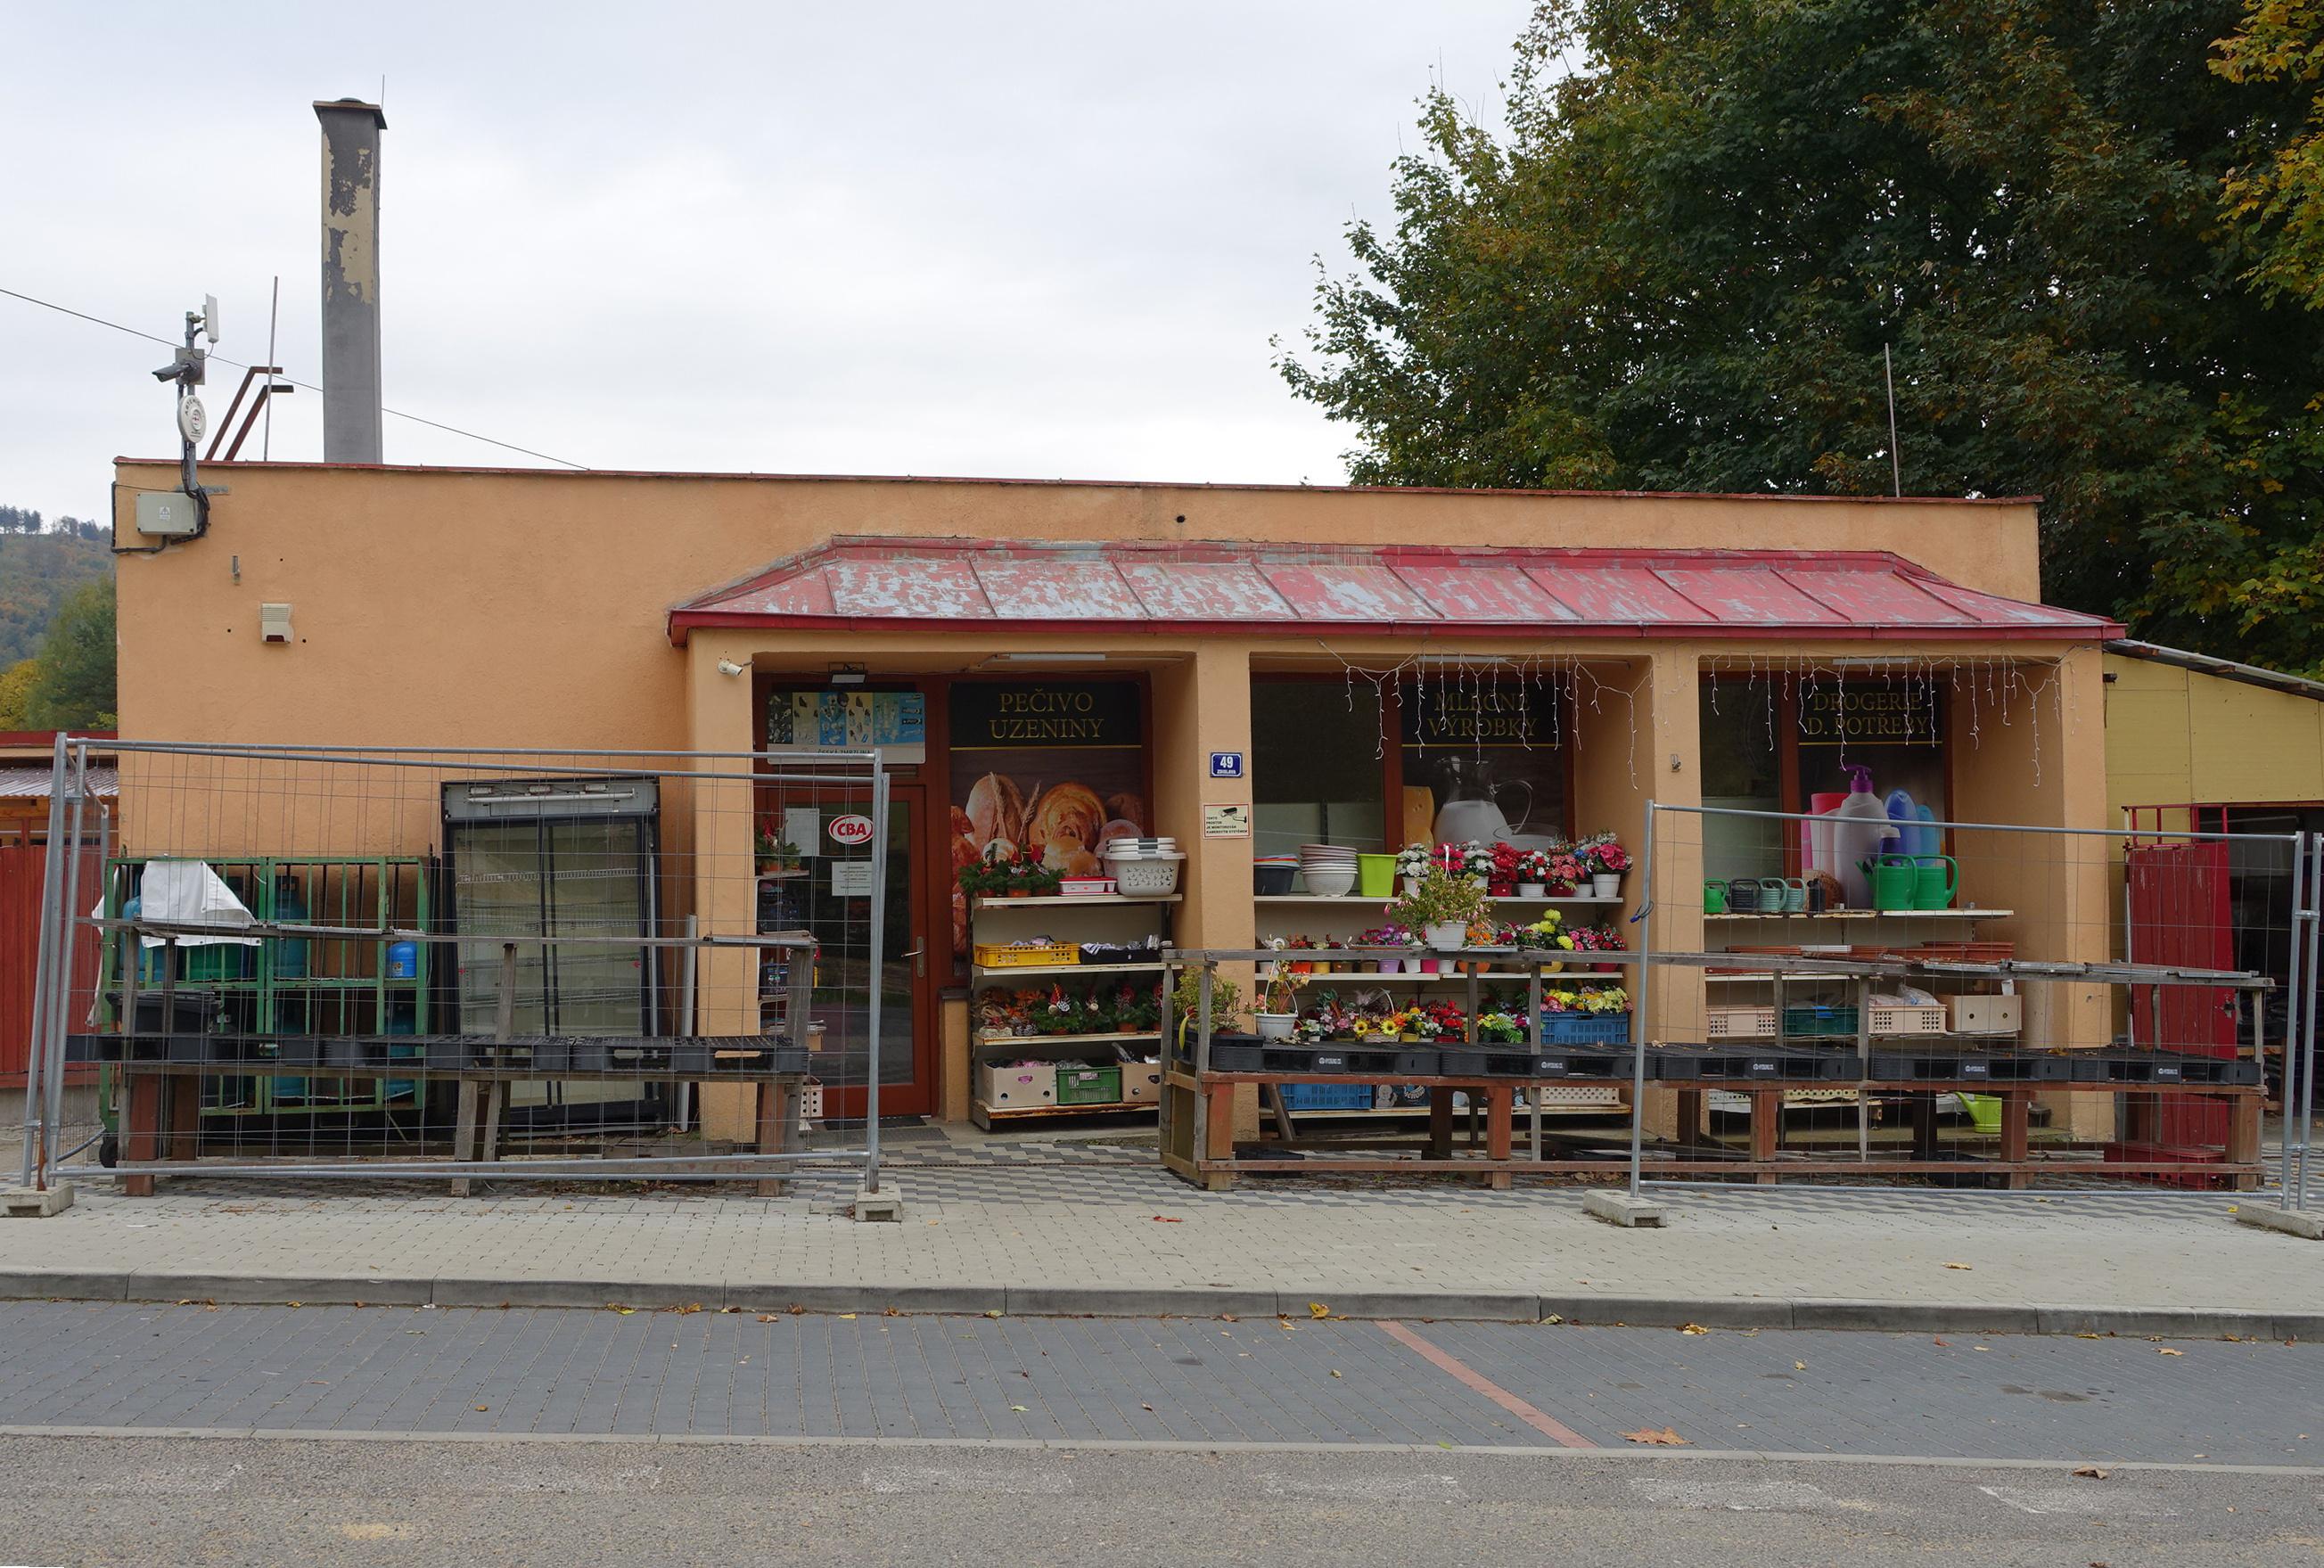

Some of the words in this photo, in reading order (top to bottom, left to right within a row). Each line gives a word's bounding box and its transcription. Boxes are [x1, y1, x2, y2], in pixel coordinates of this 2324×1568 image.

[999, 688, 1095, 712] PEČIVO
[990, 718, 1105, 739] UZENINY
[1426, 714, 1538, 737] VÝROBKY
[1806, 717, 1828, 735] D.
[1219, 755, 1234, 768] 49
[836, 822, 867, 836] CBA
